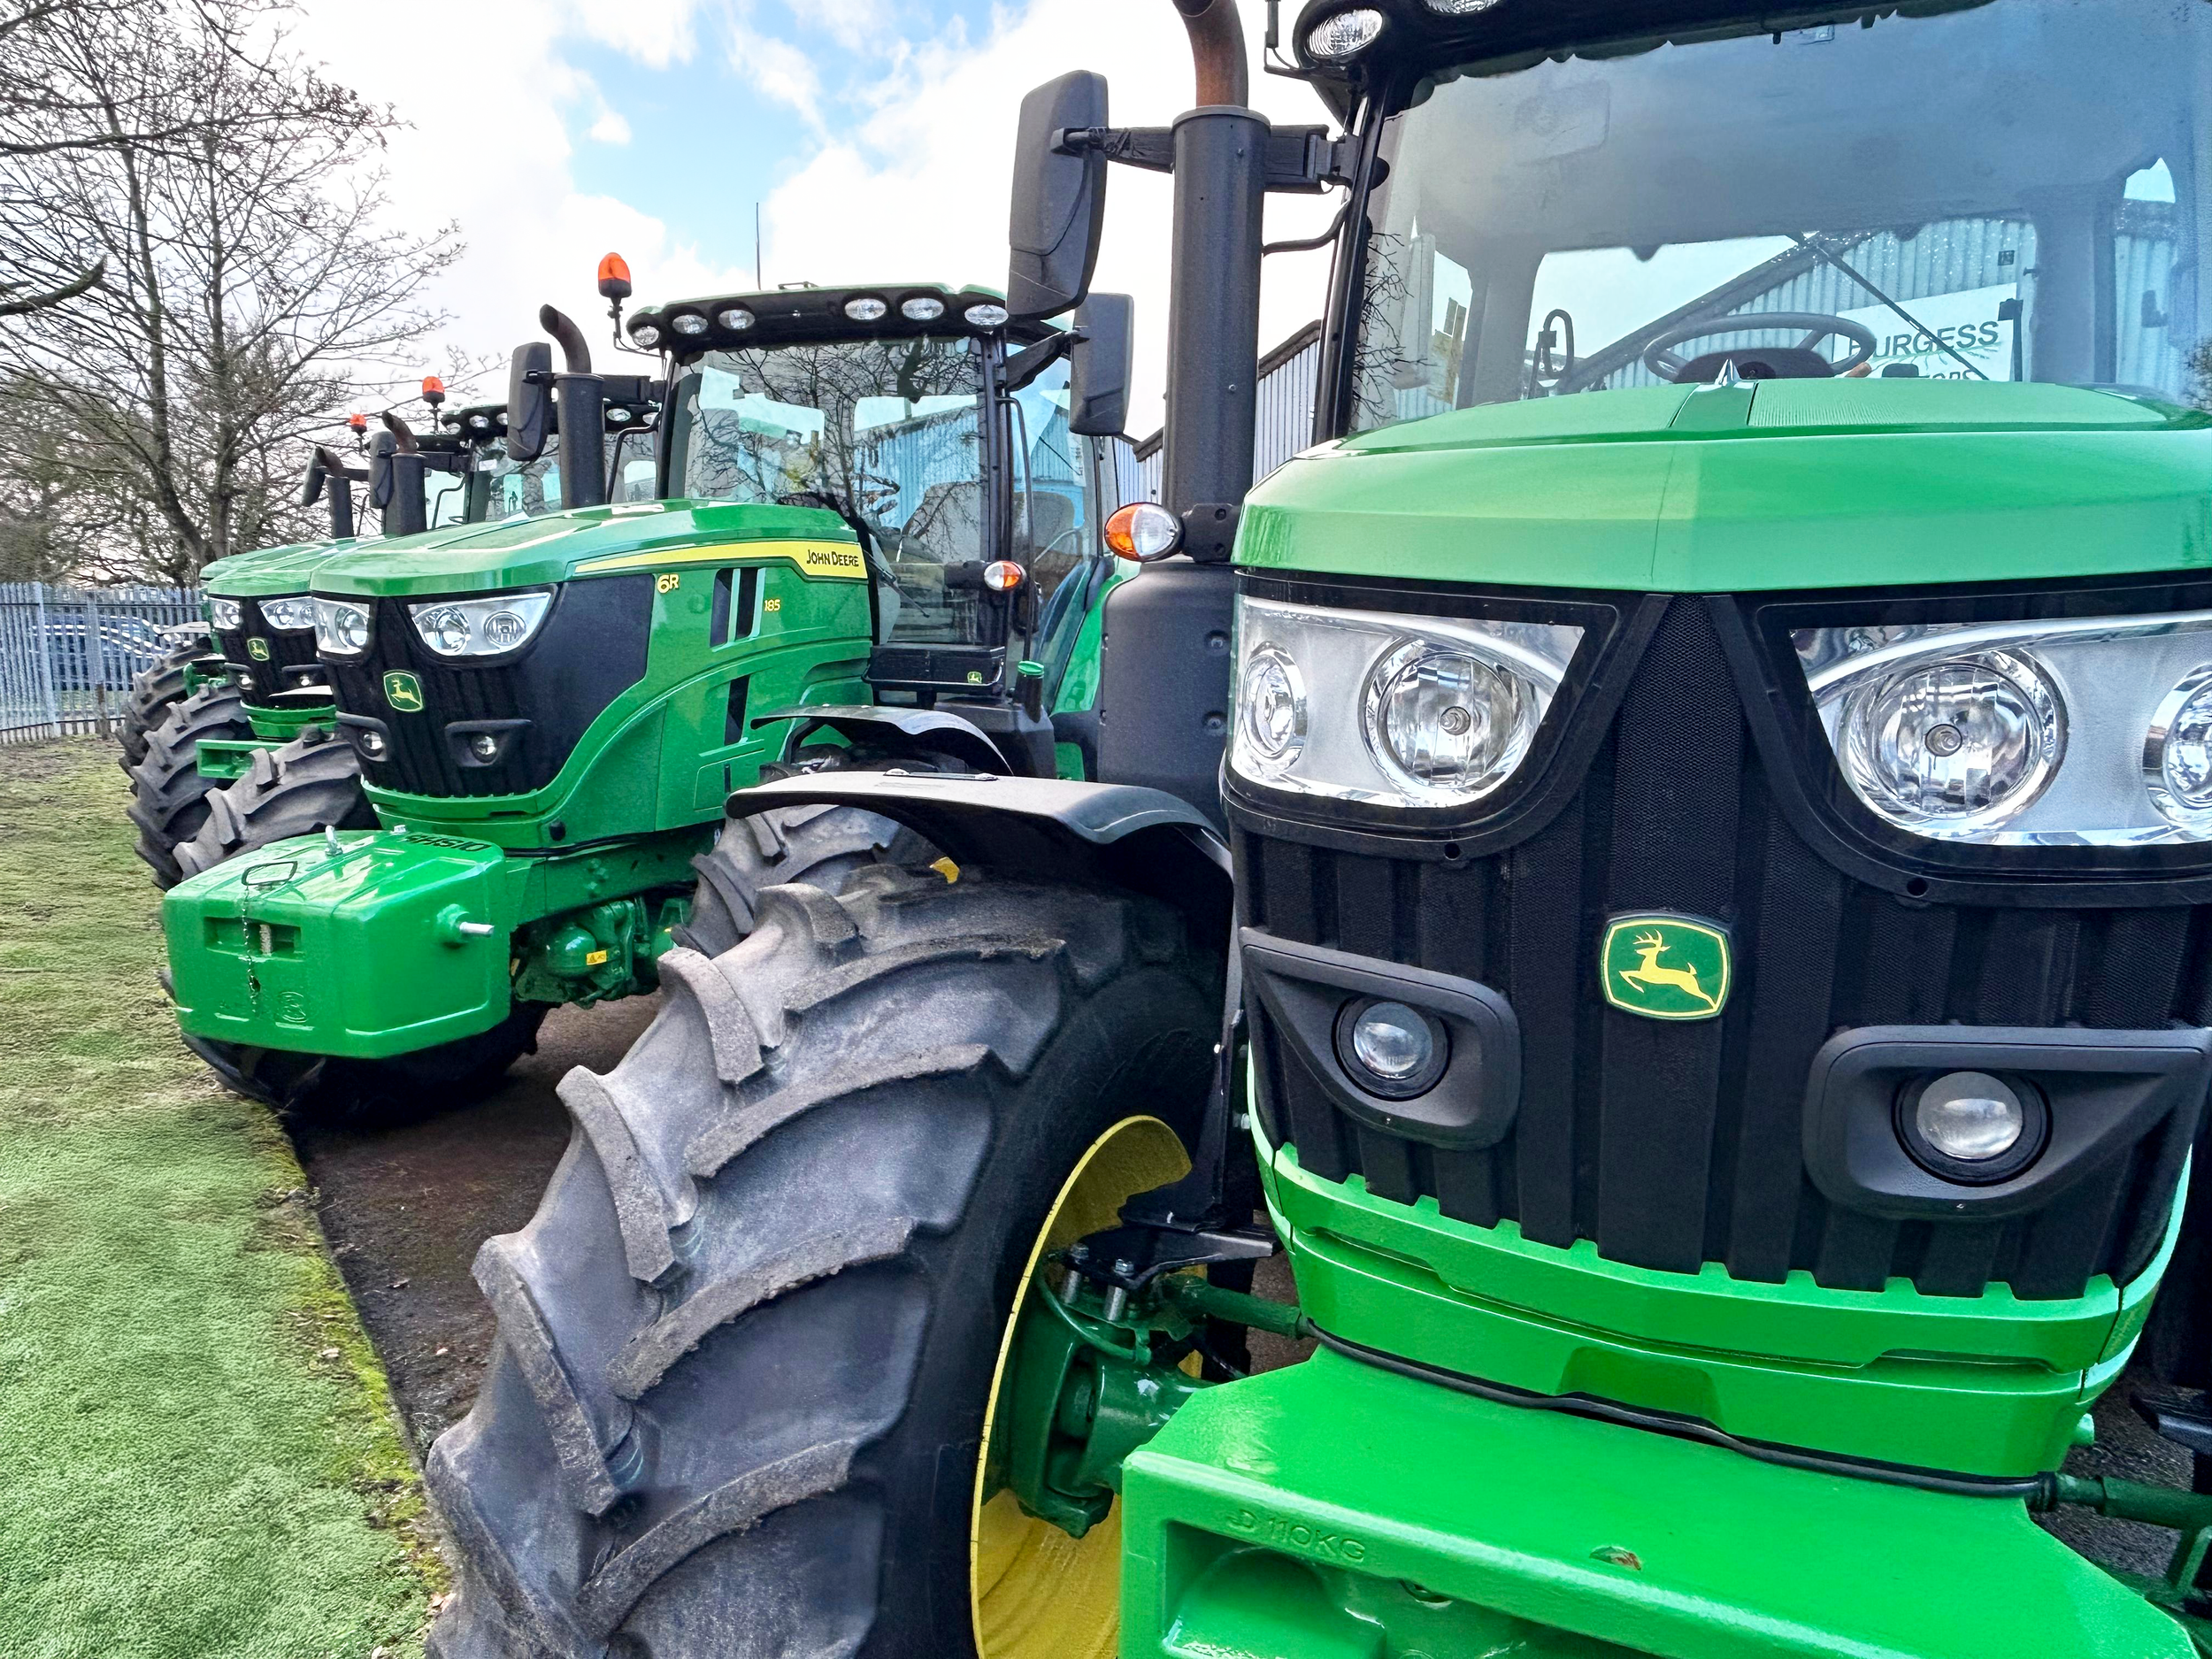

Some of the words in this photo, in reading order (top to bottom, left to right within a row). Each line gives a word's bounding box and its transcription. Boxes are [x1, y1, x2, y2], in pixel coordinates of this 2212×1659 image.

[806, 549, 831, 565] JOHN
[832, 551, 859, 567] DEERE
[657, 574, 680, 594] 6R
[764, 599, 781, 611] 185
